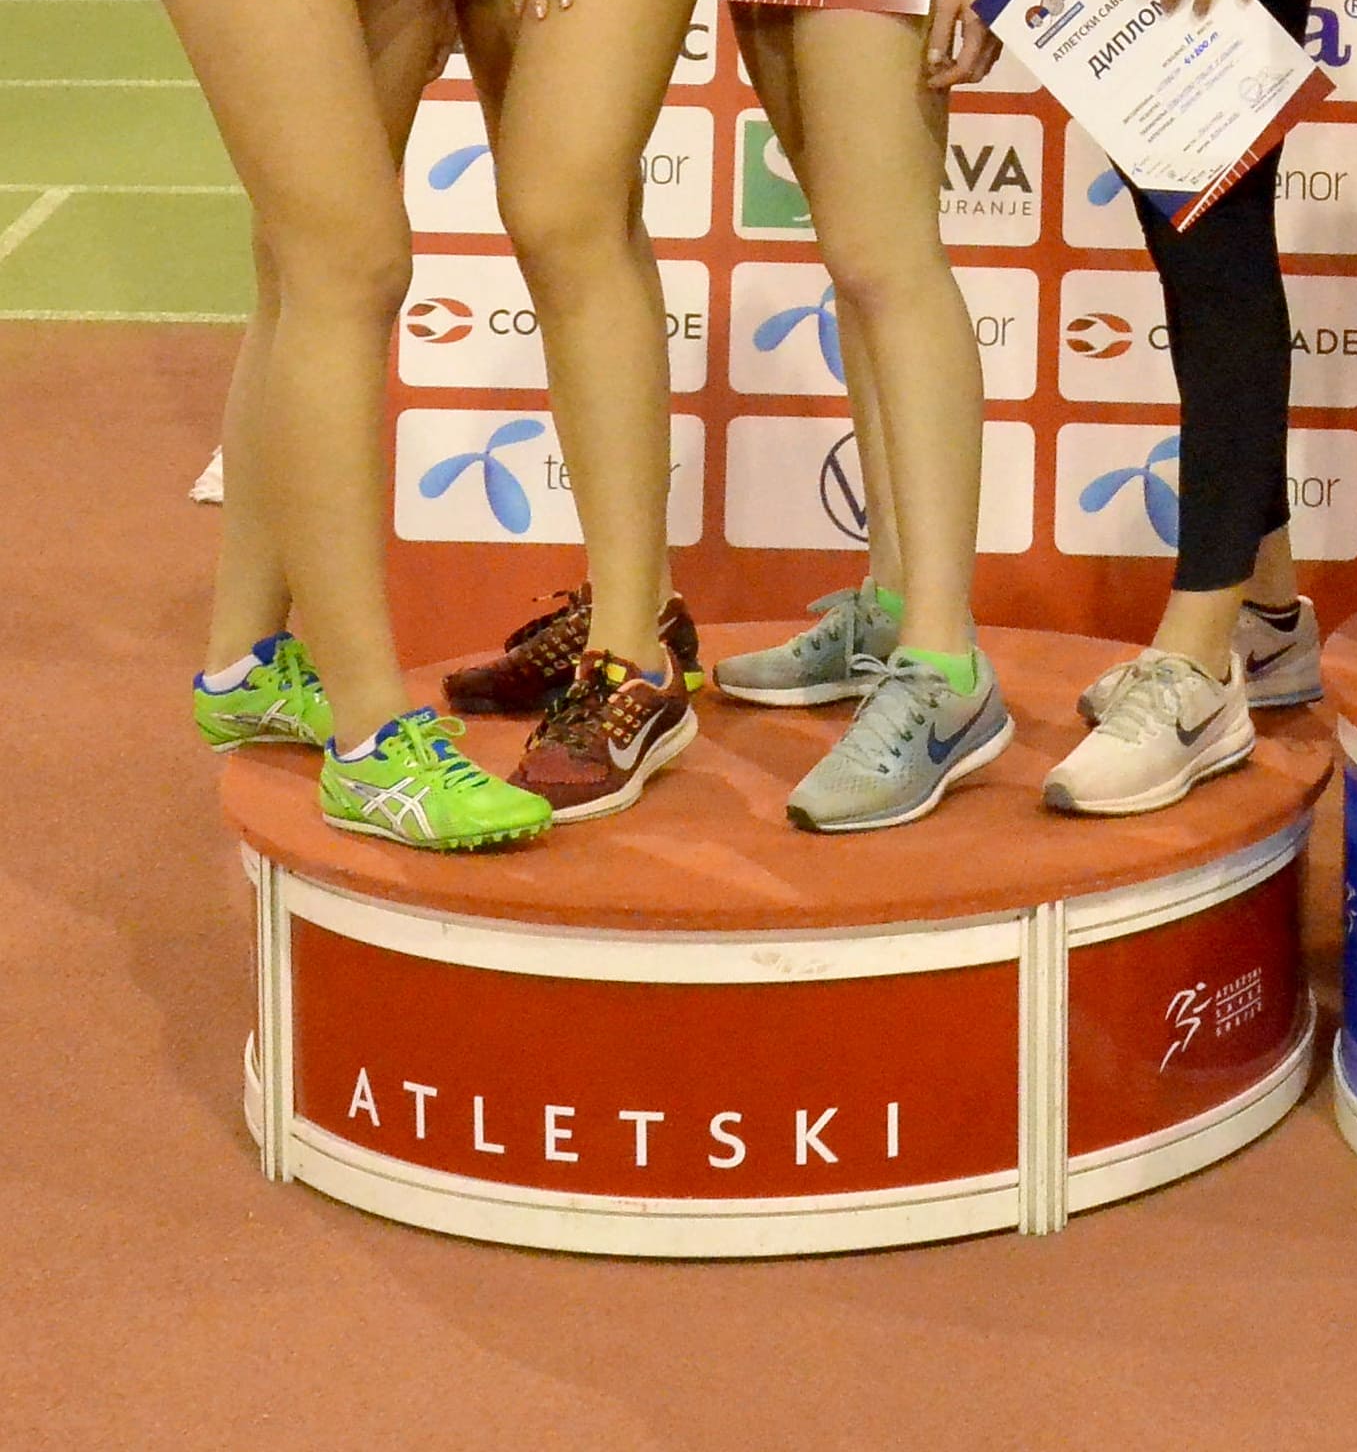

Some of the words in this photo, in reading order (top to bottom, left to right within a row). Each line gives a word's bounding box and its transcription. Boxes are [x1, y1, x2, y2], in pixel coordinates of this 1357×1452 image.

[1052, 13, 1100, 62] АТЛЕТСКИ
[940, 199, 1033, 216] URANJE
[347, 1066, 902, 1169] ATLETSKI
